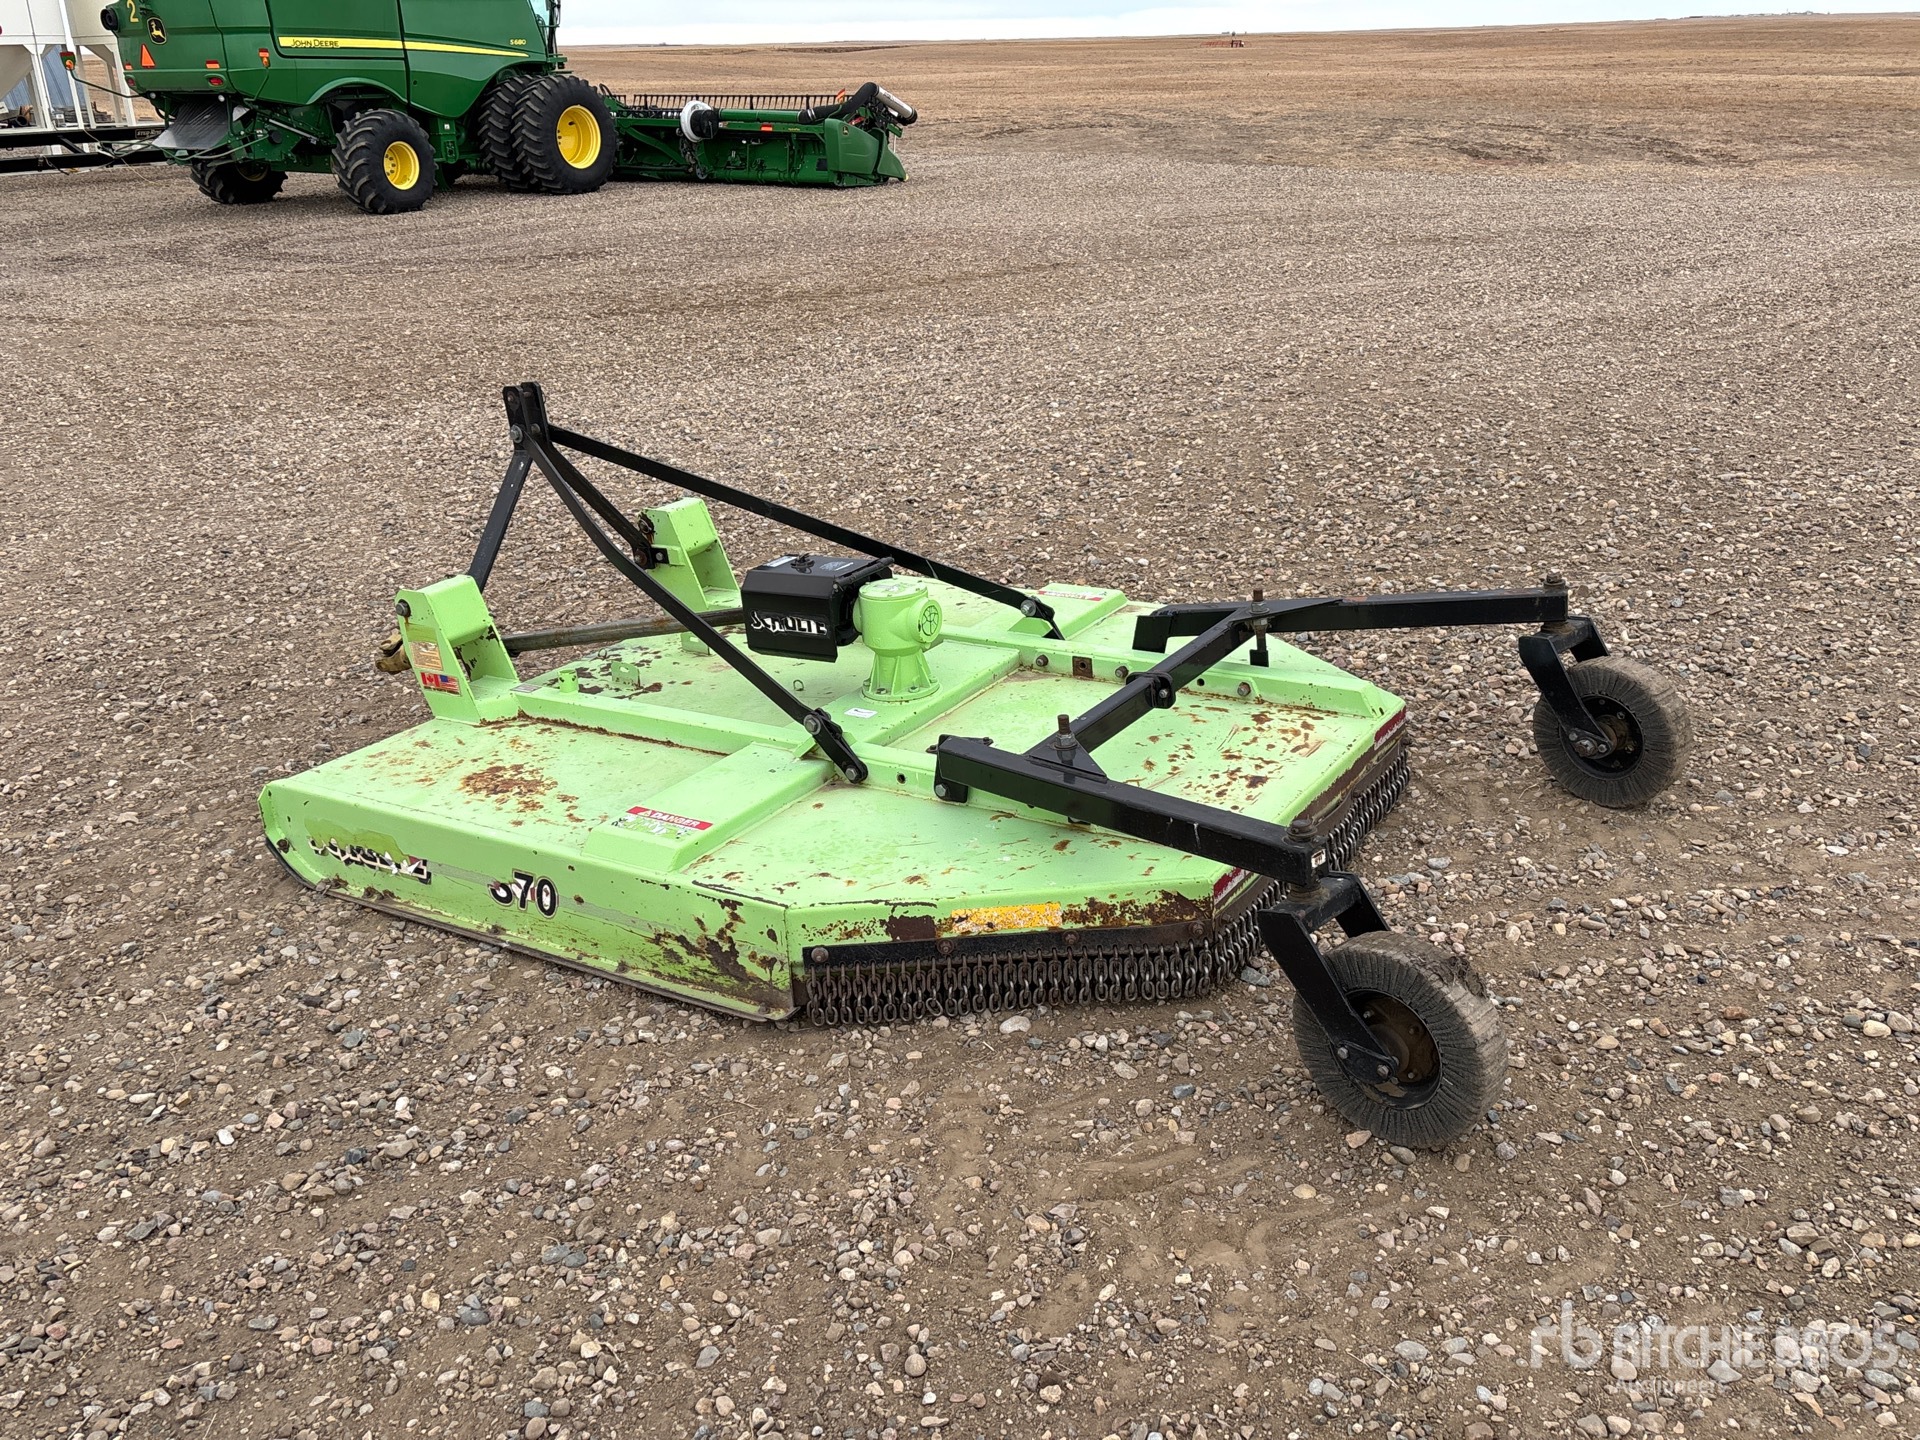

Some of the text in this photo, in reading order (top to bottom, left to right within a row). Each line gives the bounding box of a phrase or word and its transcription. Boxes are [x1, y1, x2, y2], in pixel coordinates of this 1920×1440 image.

[126, 0, 139, 22] 2
[291, 38, 339, 47] JOHN DEERE
[650, 811, 701, 828] DANGER
